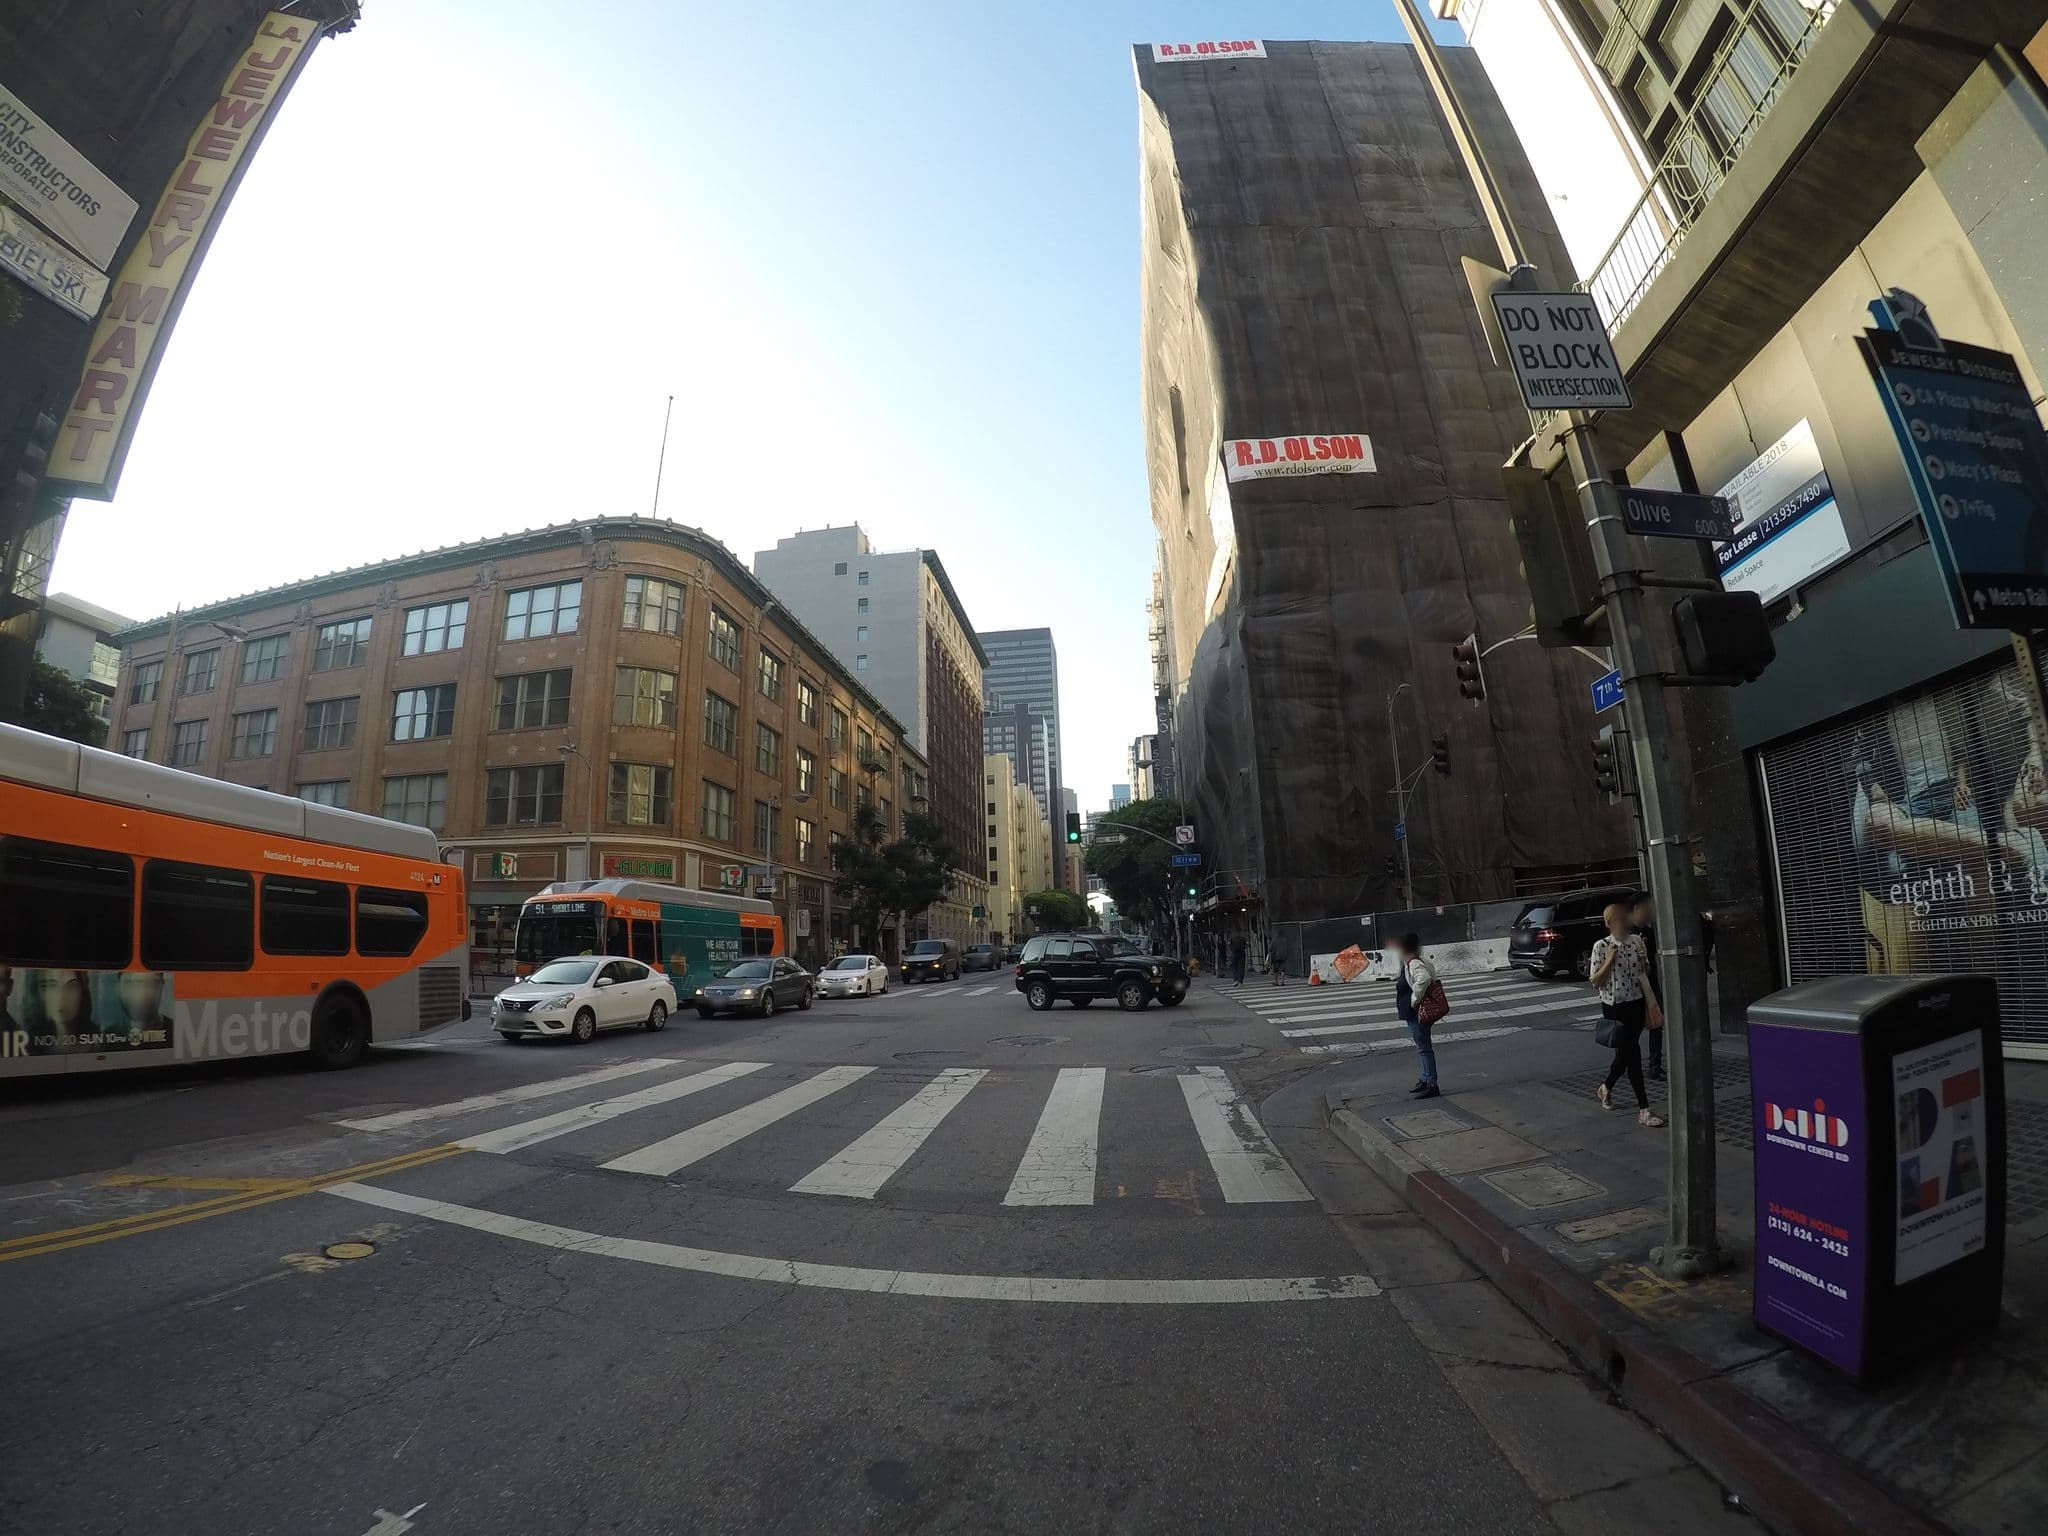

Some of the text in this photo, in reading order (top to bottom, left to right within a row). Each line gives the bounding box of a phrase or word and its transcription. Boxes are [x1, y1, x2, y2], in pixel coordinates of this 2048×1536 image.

[149, 46, 293, 268] JEWELRY
[0, 147, 59, 202] RPORATED
[1502, 306, 1595, 332] DO NOT
[1518, 343, 1610, 370] BLOCK
[67, 281, 170, 462] MART
[1526, 377, 1622, 397] INTERSECTION
[1234, 435, 1364, 467] R.D.OLSON
[1254, 462, 1352, 477] www.rdolson.com
[1720, 458, 1765, 498] AVAILABLE
[1765, 440, 1789, 465] 2018
[1627, 498, 1672, 524] Olive
[1718, 547, 1734, 565] For
[1733, 530, 1759, 555] Lease
[1763, 482, 1821, 533] 213.935.7430
[1694, 519, 1718, 536] 600
[1727, 558, 1765, 588] Retail Space
[1596, 681, 1614, 705] 7th
[263, 850, 292, 863] Nation's
[292, 855, 316, 867] Largest
[1889, 863, 1977, 917] eighth
[535, 904, 545, 914] 51
[704, 939, 715, 950] WE
[79, 1033, 104, 1045] SUN
[174, 998, 312, 1060] Metro
[1767, 1215, 1792, 1237] (213)
[1792, 1225, 1813, 1243] 624
[1821, 1237, 1849, 1258] 2425
